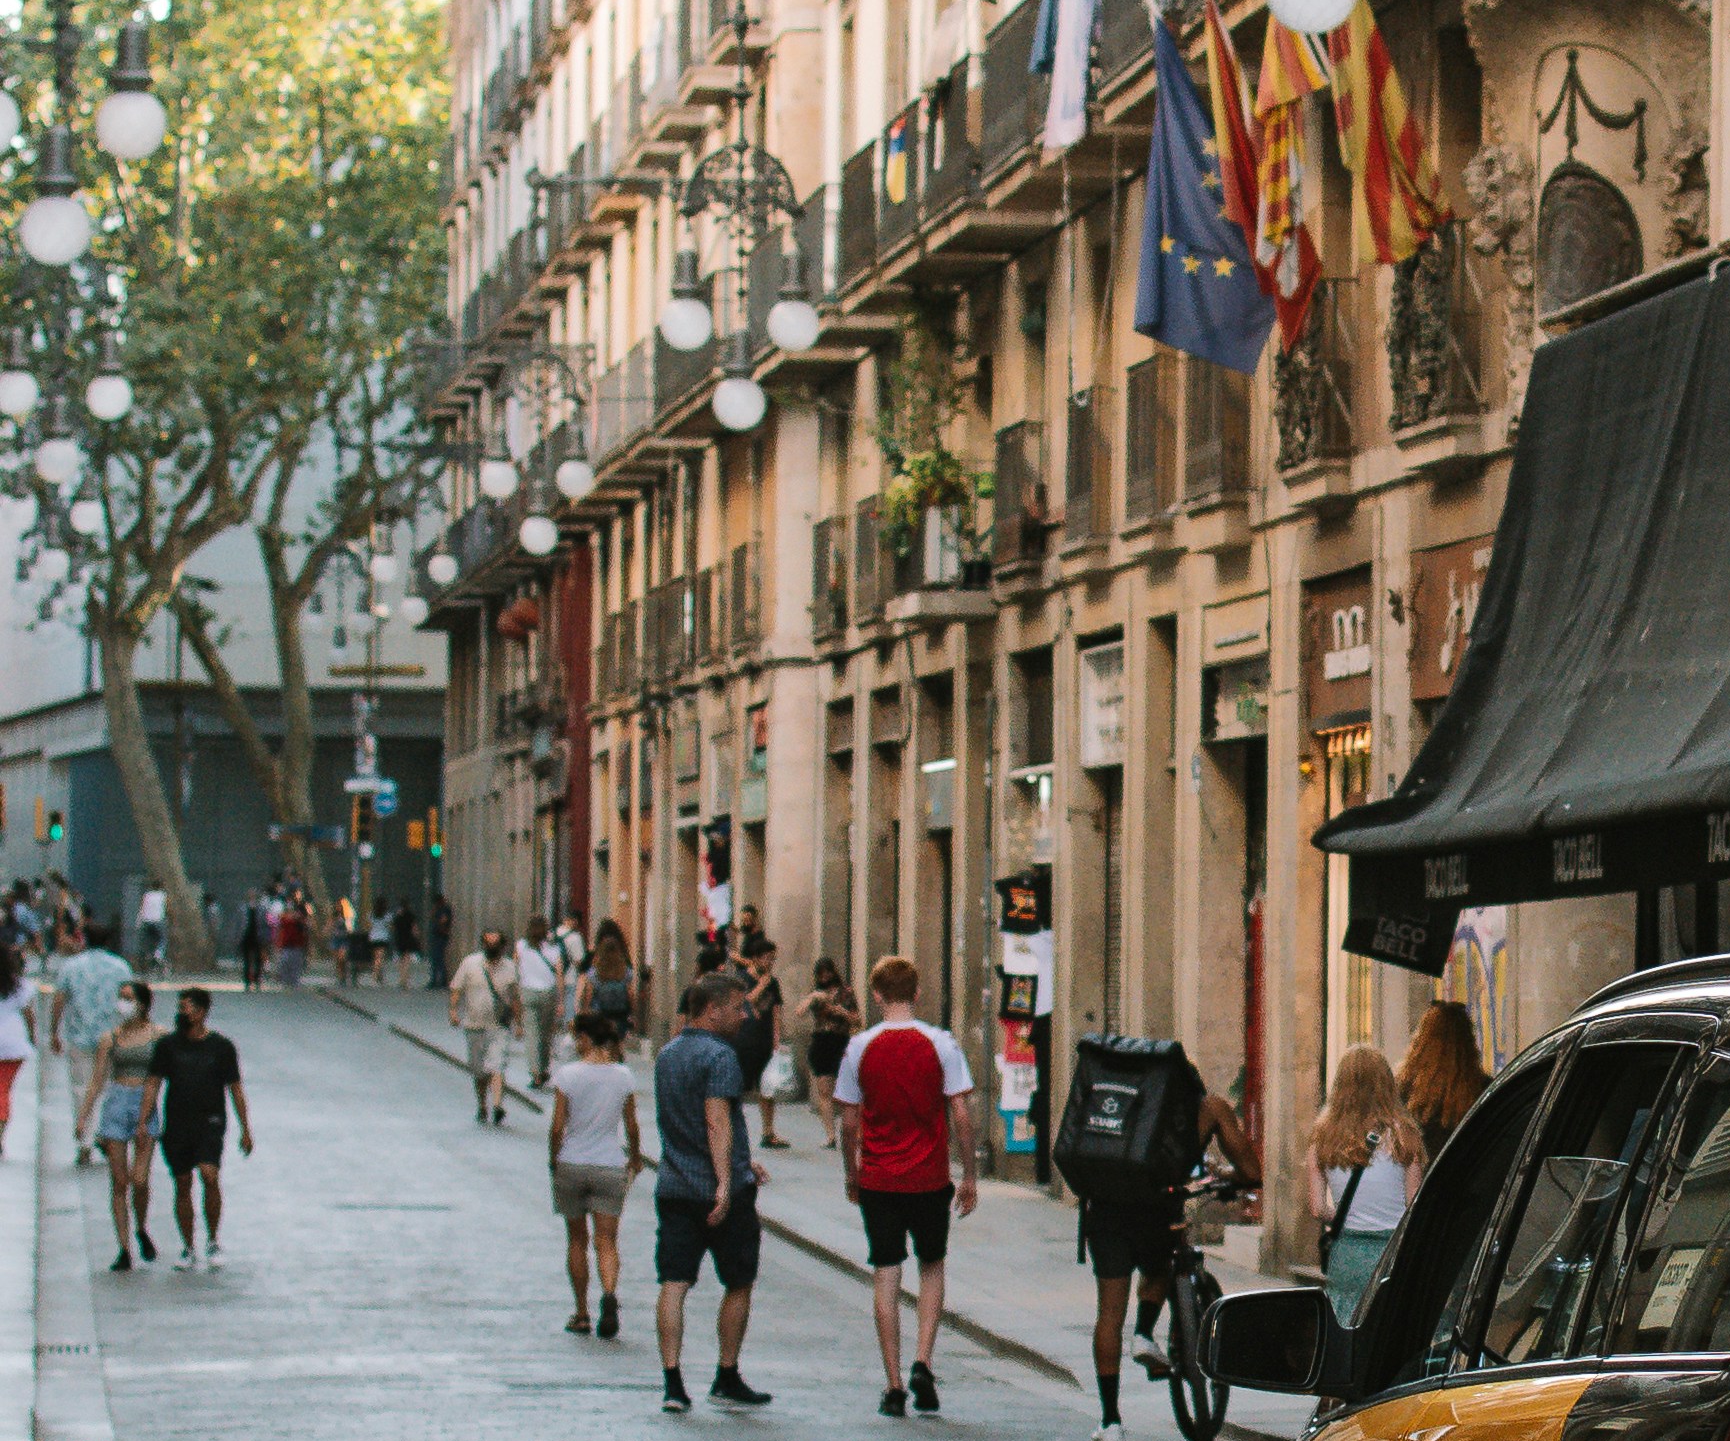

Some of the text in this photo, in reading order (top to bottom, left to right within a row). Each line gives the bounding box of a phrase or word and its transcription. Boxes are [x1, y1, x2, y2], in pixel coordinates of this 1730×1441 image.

[1553, 833, 1604, 883] TACO BELL
[1377, 914, 1426, 945] TACO
[1371, 934, 1419, 962] BELL
